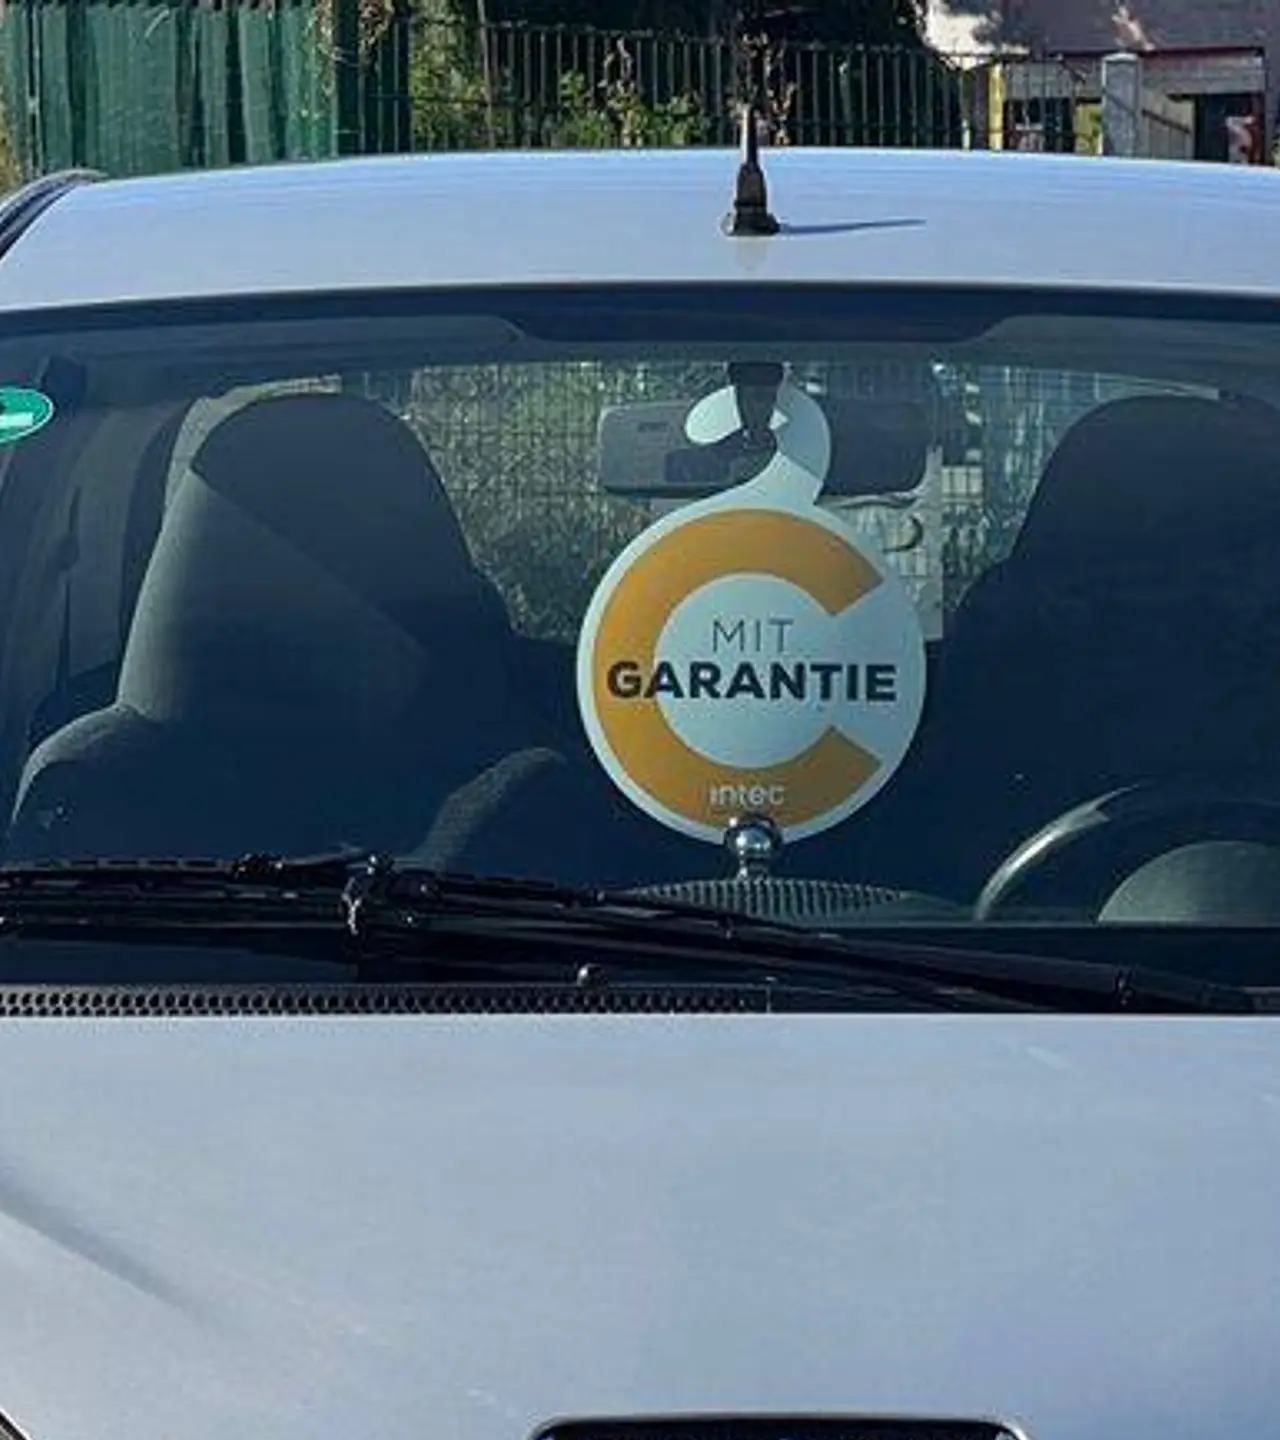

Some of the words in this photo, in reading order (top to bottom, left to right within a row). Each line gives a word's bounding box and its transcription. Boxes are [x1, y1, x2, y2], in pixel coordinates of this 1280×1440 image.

[712, 617, 795, 653] MIT
[607, 661, 897, 702] GARANTIE
[708, 783, 787, 806] intec
